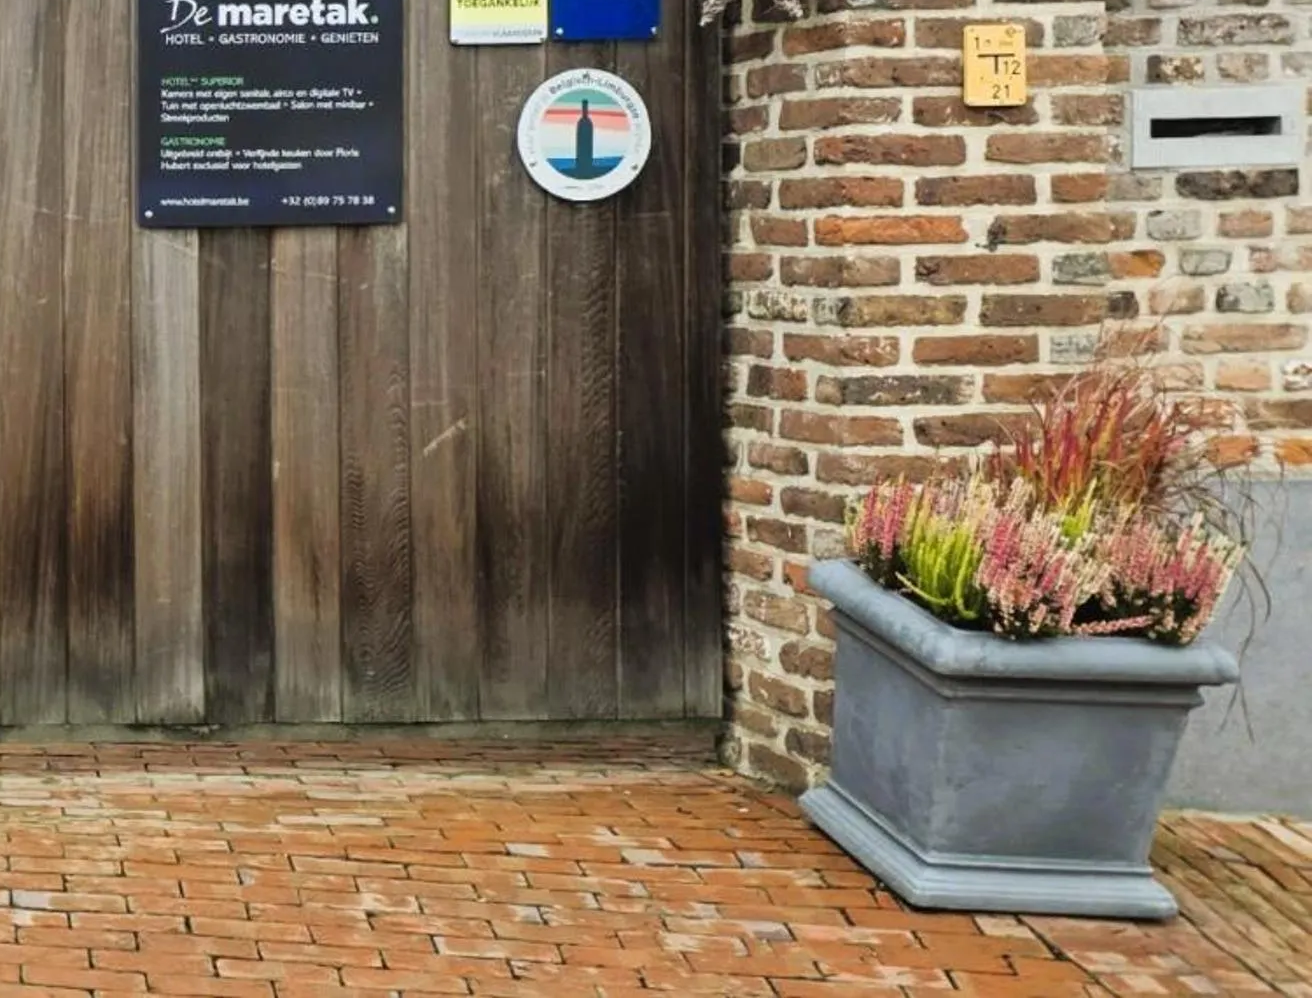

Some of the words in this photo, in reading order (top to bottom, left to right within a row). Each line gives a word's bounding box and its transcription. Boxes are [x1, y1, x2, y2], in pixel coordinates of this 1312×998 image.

[165, 33, 204, 45] HOTEL
[218, 32, 306, 44] GASTRONOMIE
[320, 31, 379, 44] GENIETEN
[342, 87, 354, 97] TV
